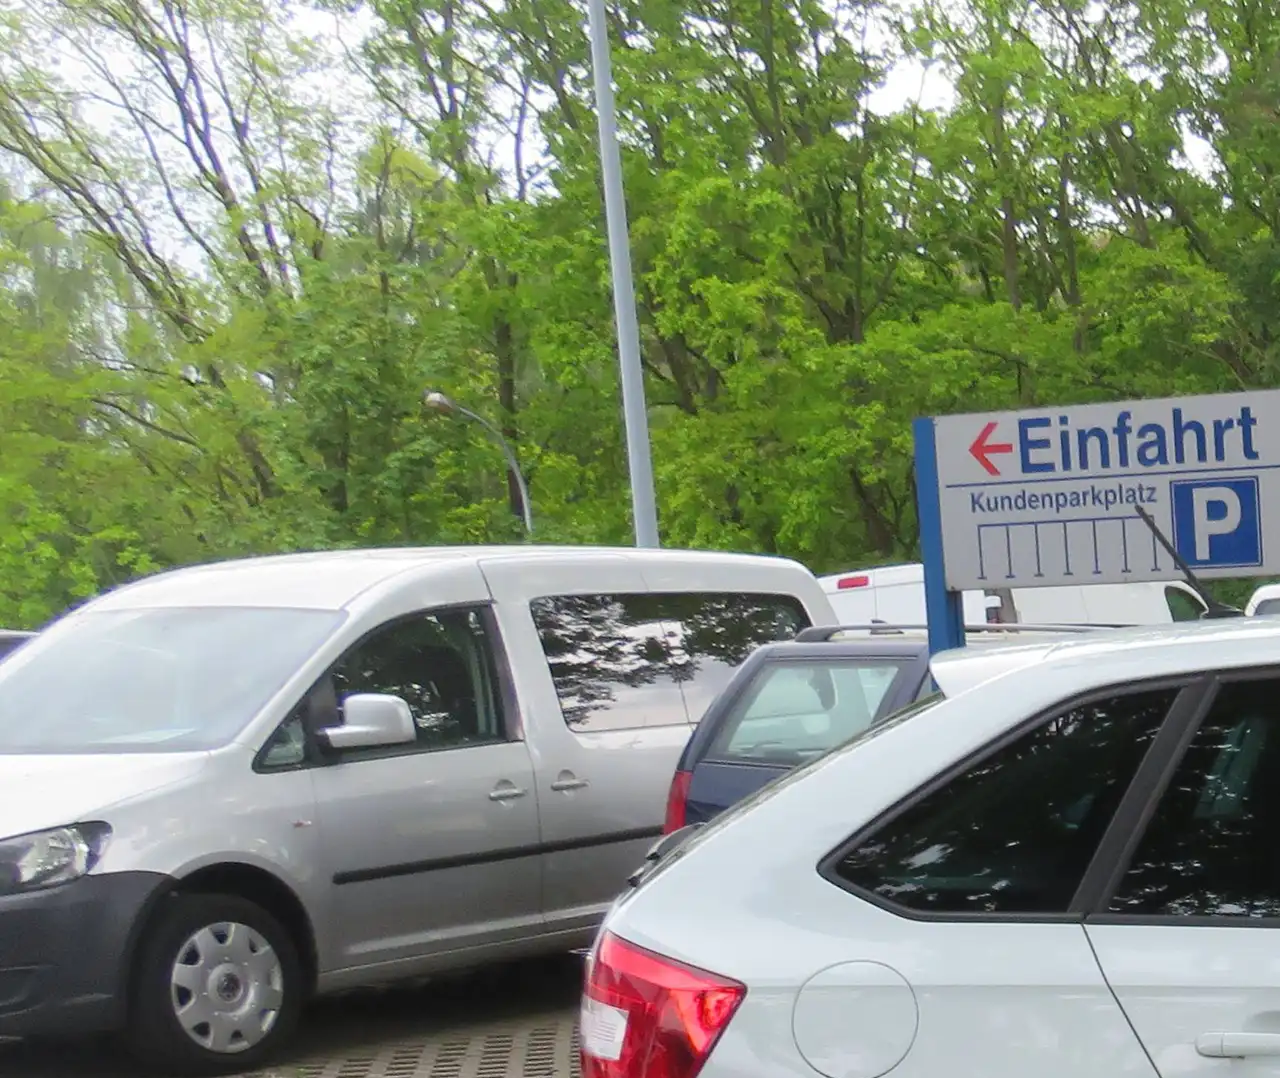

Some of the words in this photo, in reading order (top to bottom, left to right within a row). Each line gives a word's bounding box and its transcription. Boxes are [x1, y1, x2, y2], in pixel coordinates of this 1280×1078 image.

[1017, 406, 1260, 475] Einfahrt
[970, 482, 1158, 515] Kundenparkplatz
[1191, 486, 1241, 561] P
